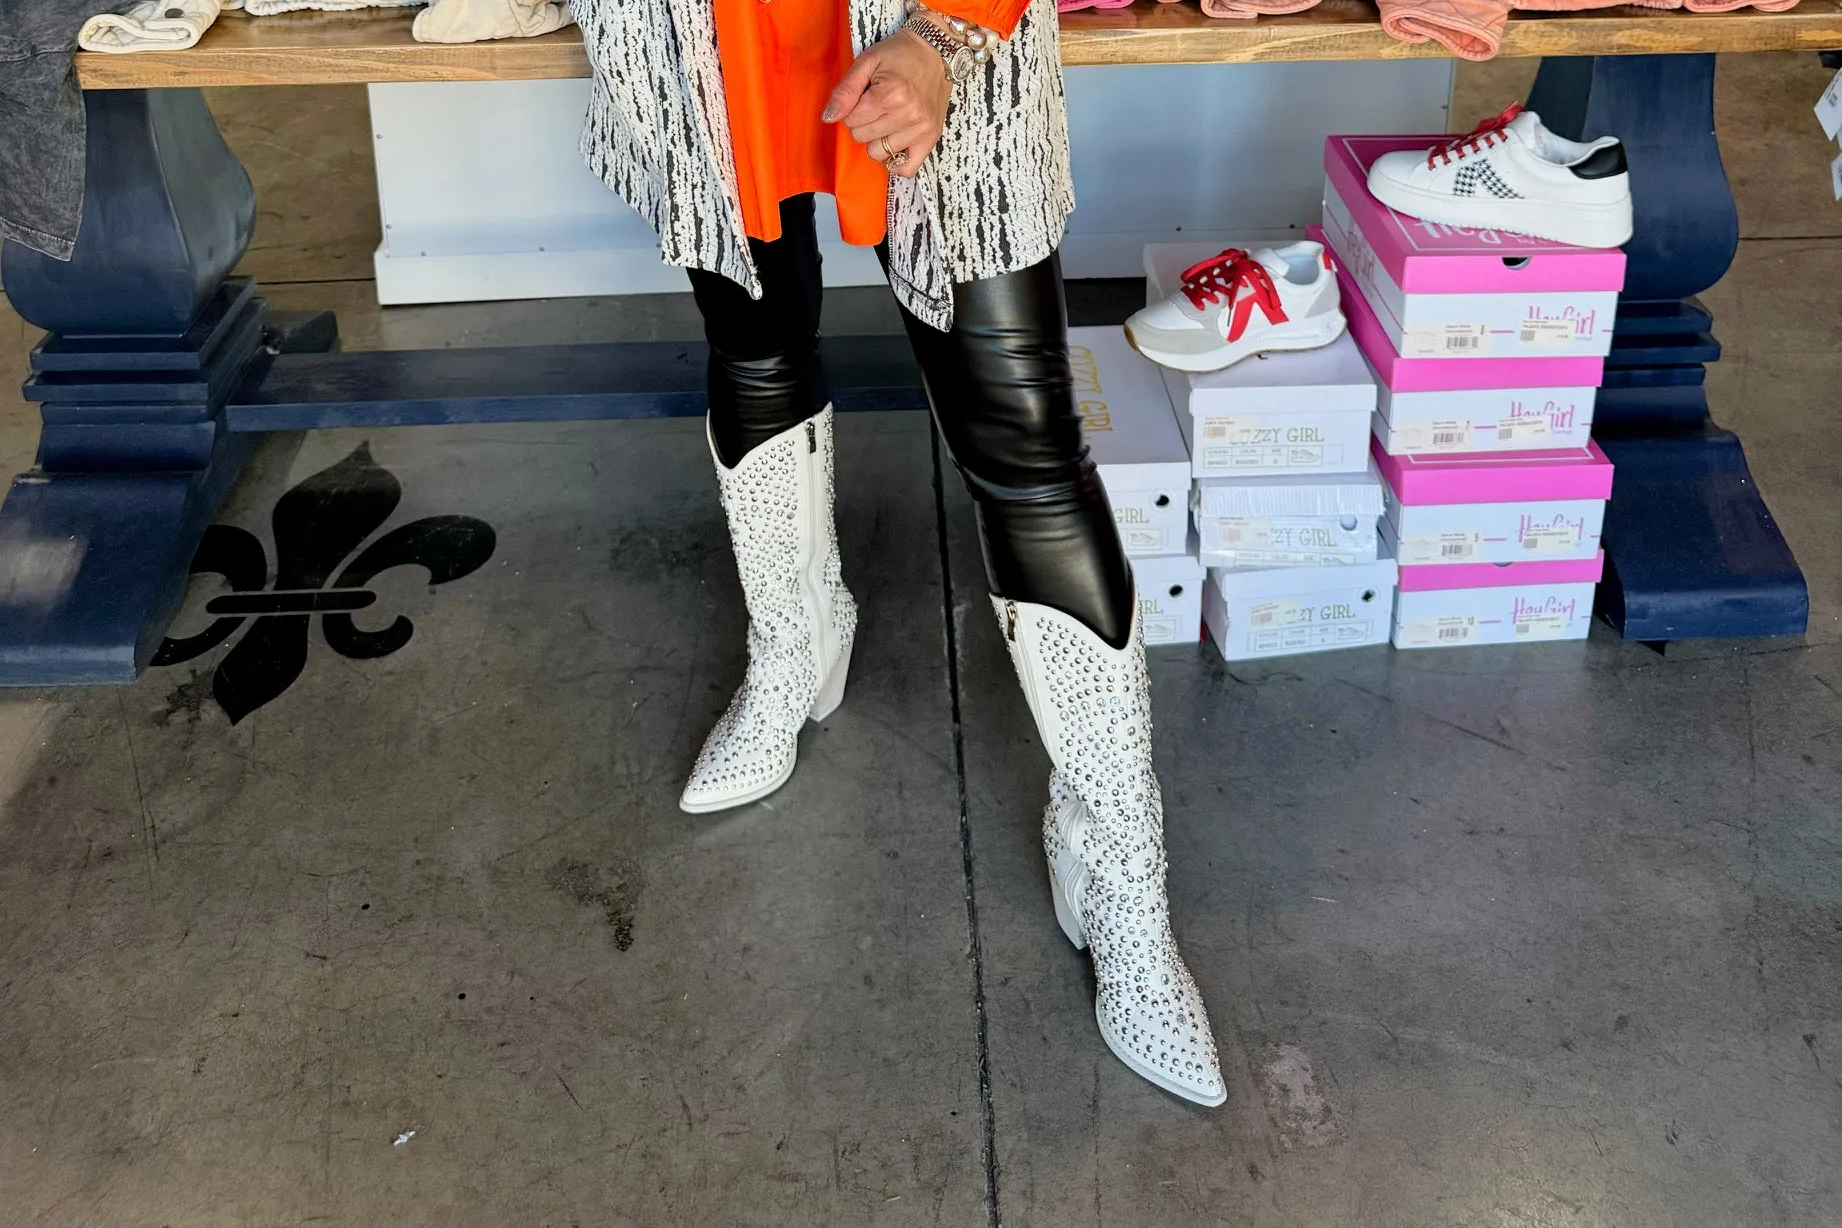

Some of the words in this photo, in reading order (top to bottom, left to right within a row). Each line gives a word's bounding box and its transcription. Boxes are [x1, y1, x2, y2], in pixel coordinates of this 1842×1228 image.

[1286, 427, 1325, 444] GIRL
[1114, 507, 1150, 524] GIRL
[1299, 527, 1337, 547] GIRL
[1319, 604, 1356, 621] GIRL
